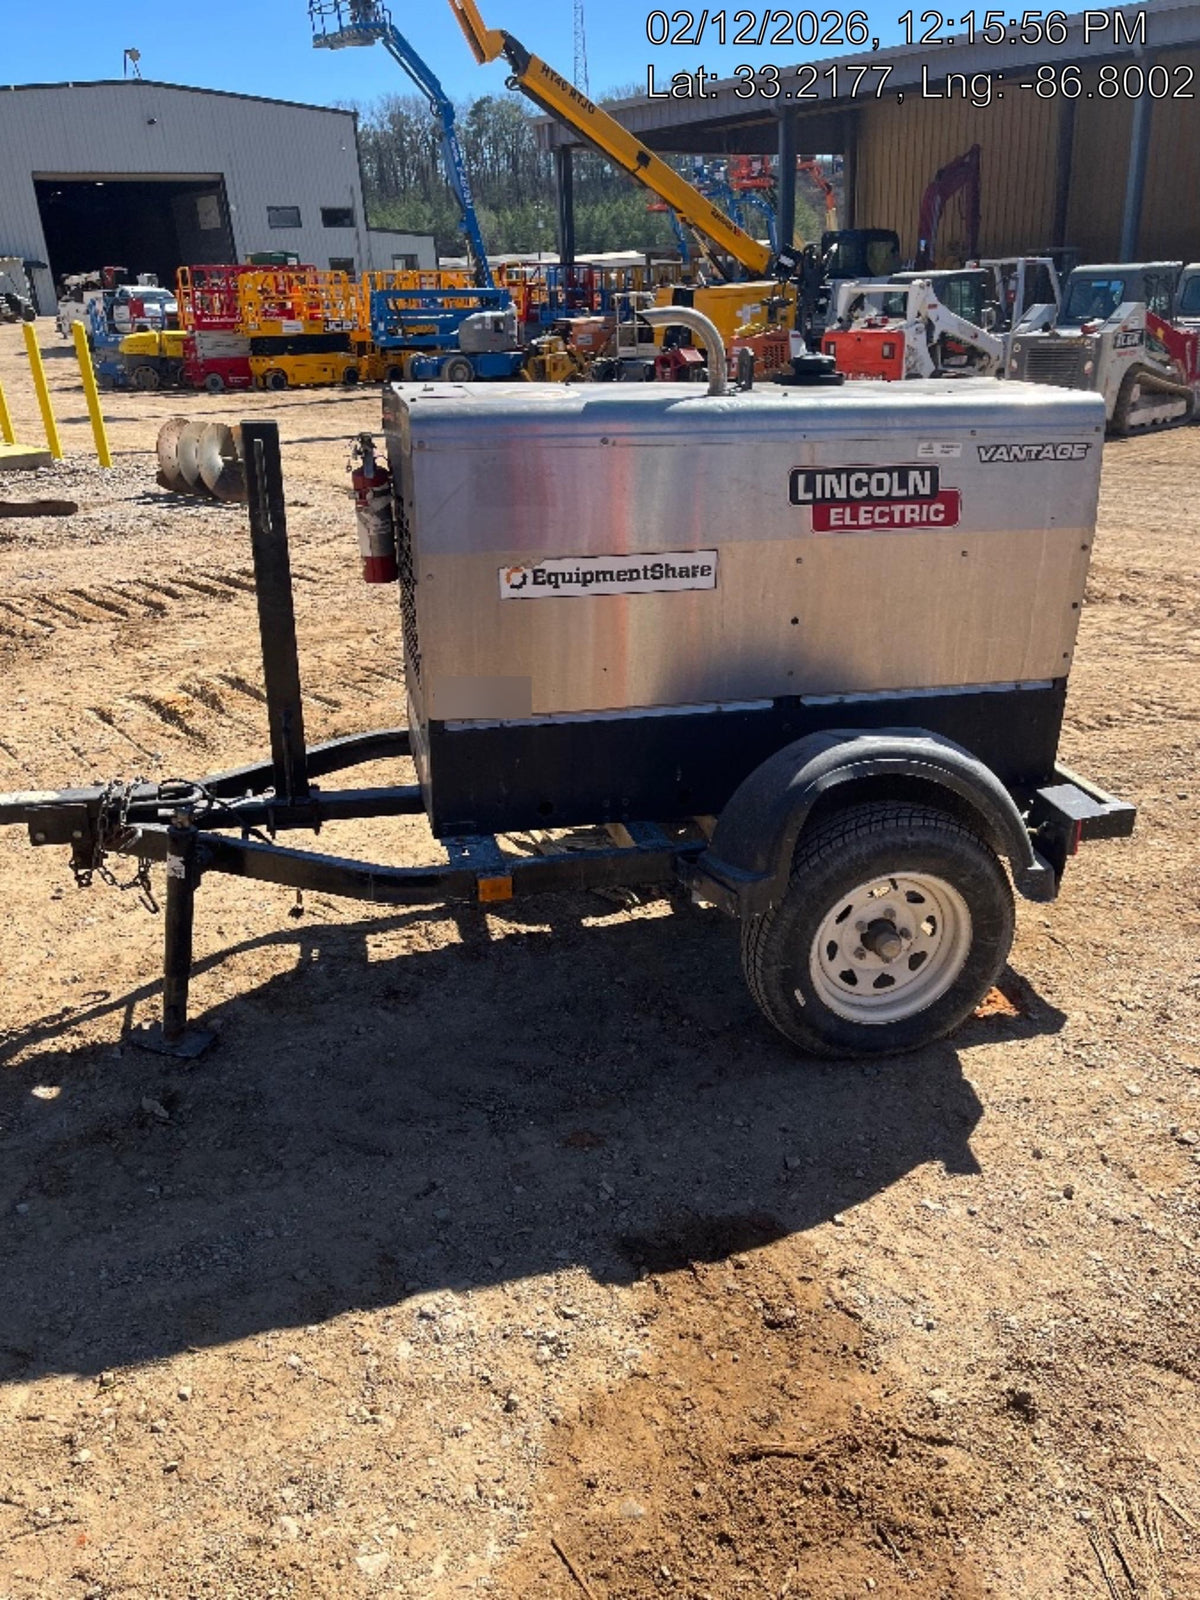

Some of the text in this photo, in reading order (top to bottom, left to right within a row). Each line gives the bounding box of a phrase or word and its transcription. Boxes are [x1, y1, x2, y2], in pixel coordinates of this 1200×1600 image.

[977, 443, 1091, 462] VANTAGE
[797, 470, 931, 500] LINCOLN
[829, 503, 945, 526] ELECTRIC
[531, 562, 712, 588] EquipmentShare
